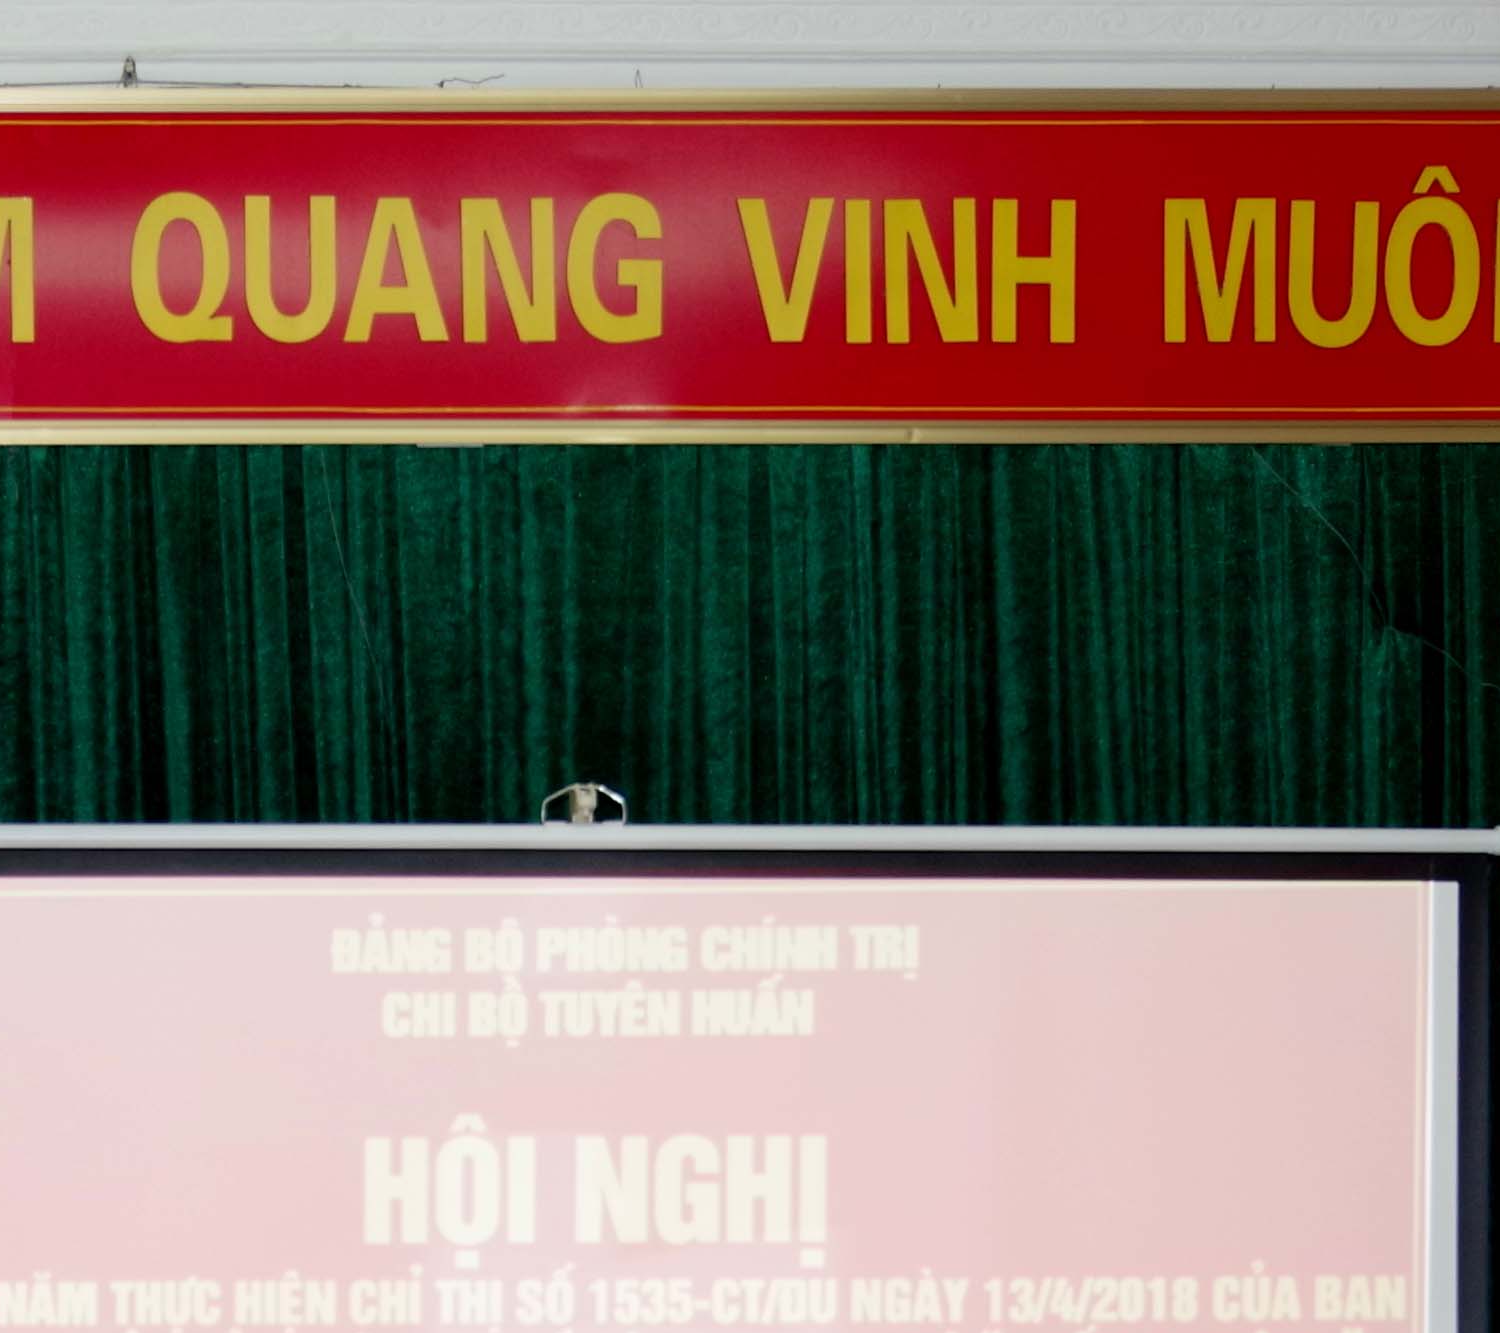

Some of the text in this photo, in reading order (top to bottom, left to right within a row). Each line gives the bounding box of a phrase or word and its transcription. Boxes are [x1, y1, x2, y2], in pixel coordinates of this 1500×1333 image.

[129, 191, 665, 346] QUANG
[738, 196, 1078, 344] VINH
[331, 912, 919, 980] ĐẢNG BỘ PHÒNG CHÍNH TRỊ
[382, 974, 816, 1048] CHI BỘ TUYÊN HUẤN
[363, 1113, 827, 1269] HỘI NGHỊ
[348, 1265, 421, 1325] CHỈ
[515, 1262, 576, 1325] SỐ
[849, 1268, 968, 1323] NGÀY
[982, 1274, 1198, 1323] 13/4/2018
[1211, 1260, 1302, 1321] CỦA
[1313, 1274, 1406, 1321] BAN
